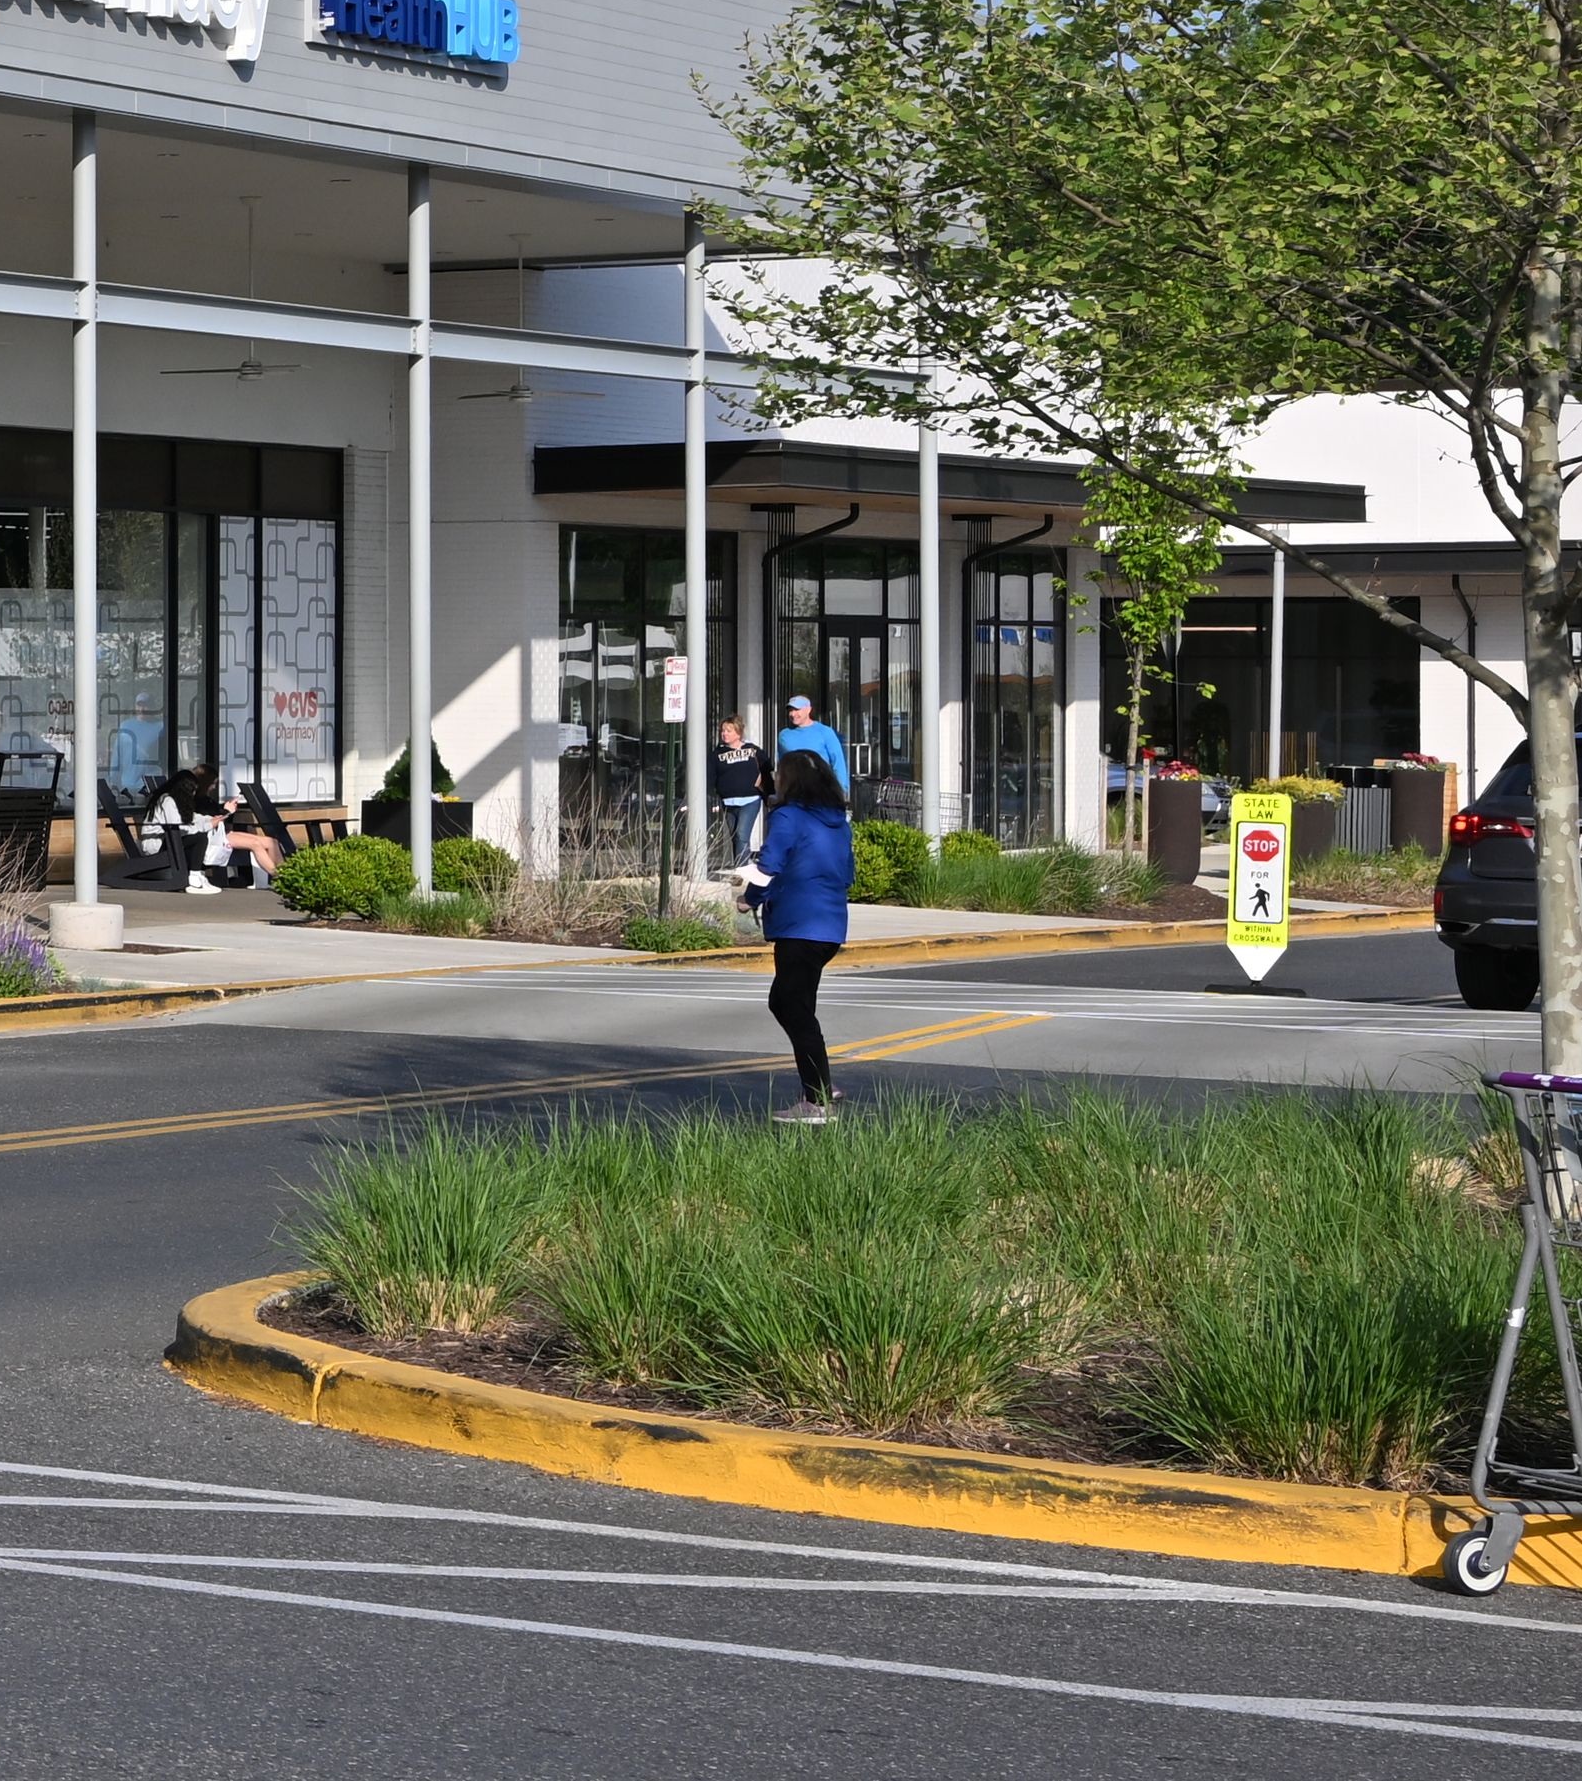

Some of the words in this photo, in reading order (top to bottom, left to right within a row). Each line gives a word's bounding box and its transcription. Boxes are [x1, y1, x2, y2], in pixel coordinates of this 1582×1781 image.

[288, 691, 318, 719] CVS
[275, 726, 316, 744] pharmacy
[1243, 798, 1281, 809] STATE
[1249, 810, 1274, 820] LAW
[1244, 839, 1278, 853] STOP
[1250, 871, 1270, 879] FOR
[1244, 925, 1272, 933] WITHIN
[1233, 934, 1281, 943] CROSSWALK
